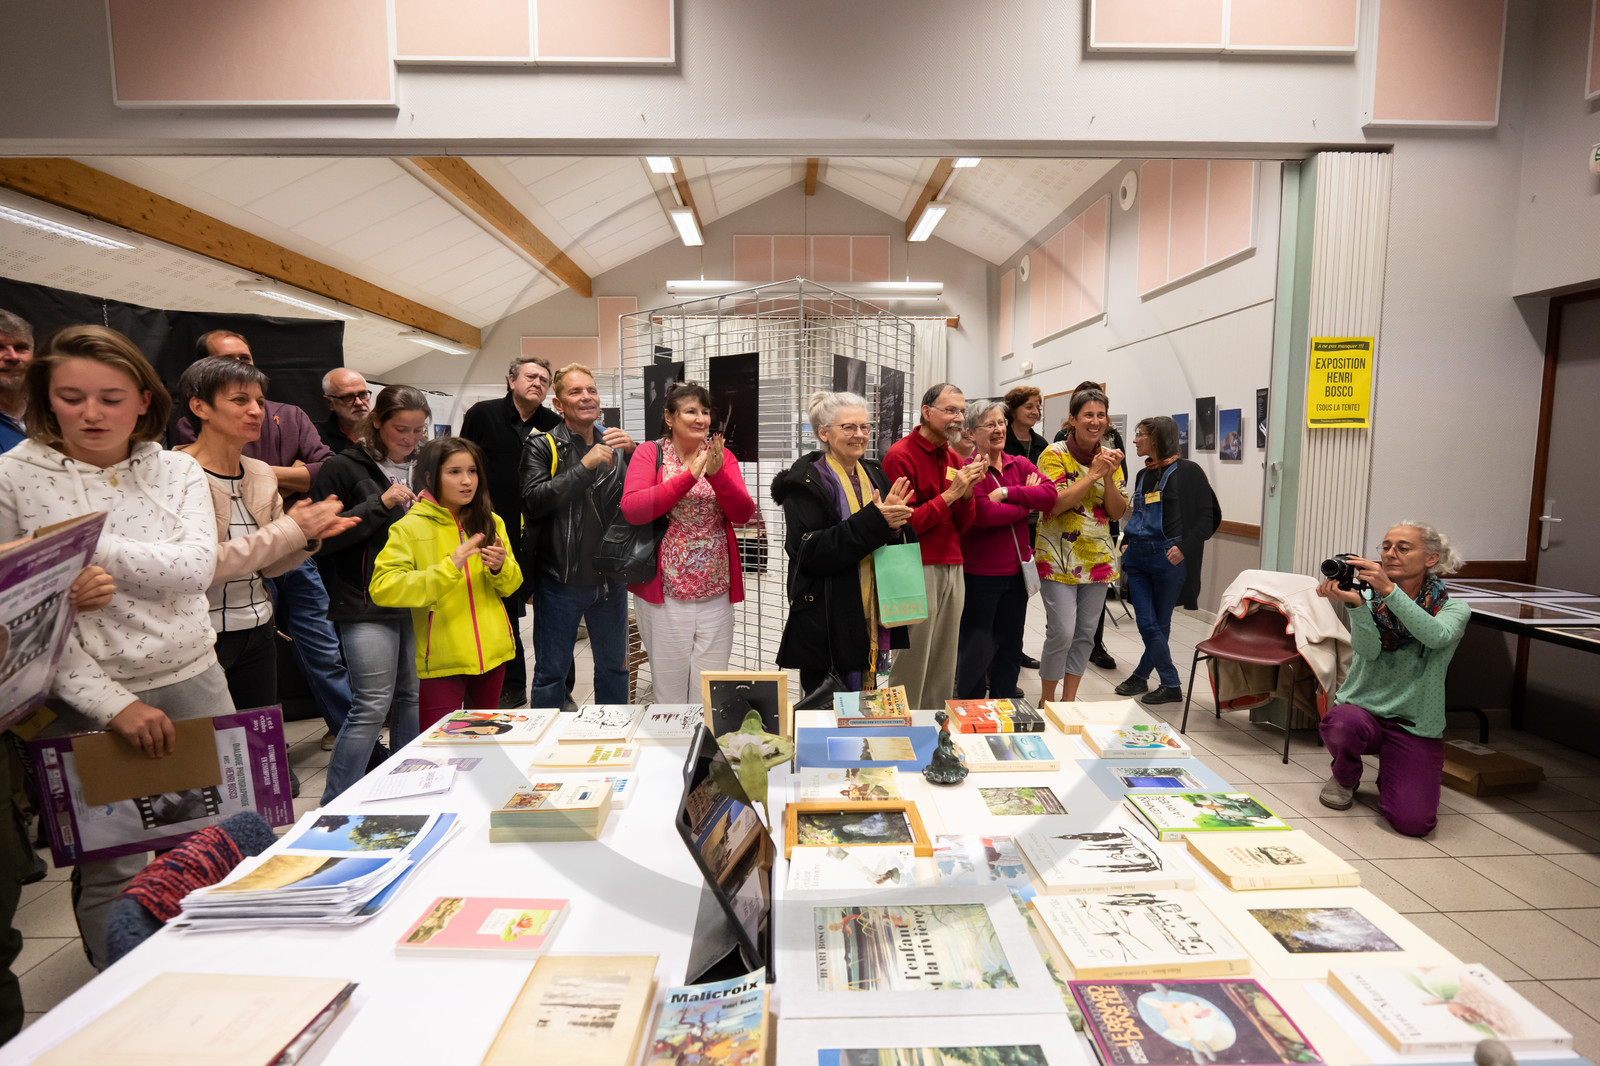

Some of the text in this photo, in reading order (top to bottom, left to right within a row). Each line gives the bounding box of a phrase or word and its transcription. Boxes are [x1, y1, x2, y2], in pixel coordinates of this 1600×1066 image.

[1315, 358, 1366, 369] EXPOSITION
[1326, 372, 1353, 383] HENRI
[1324, 386, 1354, 397] BOSCO
[881, 601, 925, 618] BABEL
[267, 744, 276, 763] AUTOMNE
[225, 766, 235, 784] HENRI
[232, 742, 249, 807] DIALOGUE PHOTOGRAPHIQUE
[227, 783, 239, 800] BOSCO
[914, 910, 935, 956] rivière
[817, 924, 828, 979] HENRI BOSCO
[924, 962, 940, 975] la
[670, 980, 758, 1004] Malicroix
[1087, 985, 1132, 1047] LE RENARD
[1111, 1004, 1144, 1040] DANS
